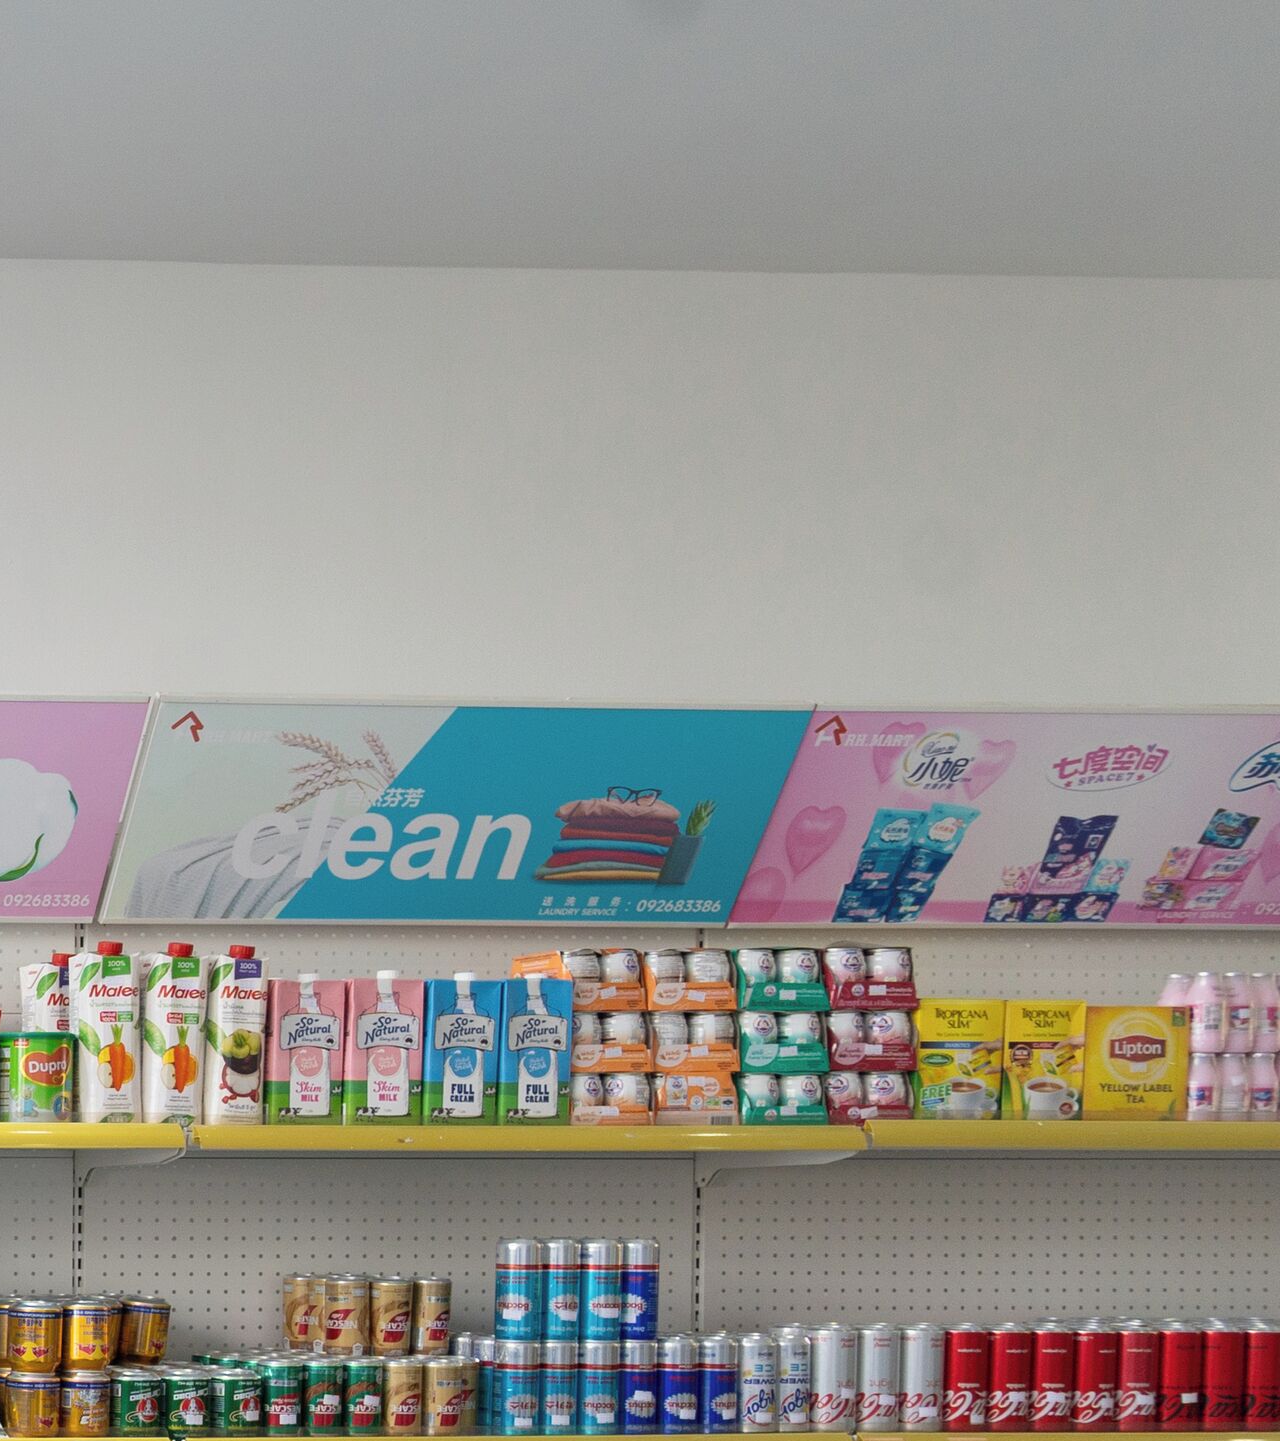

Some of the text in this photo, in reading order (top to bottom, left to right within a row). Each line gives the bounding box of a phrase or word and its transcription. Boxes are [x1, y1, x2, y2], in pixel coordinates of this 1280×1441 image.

[1052, 745, 1171, 781] 七度空间
[1077, 772, 1136, 787] SPACE7
[230, 788, 533, 881] clean
[2, 894, 91, 909] 092683386
[636, 900, 721, 914] 092683386
[538, 907, 617, 917] LAUNDRY SERVICE
[107, 960, 127, 968] 100%
[176, 961, 195, 970] 100%
[238, 962, 258, 971] 100%
[89, 983, 139, 999] Malee
[157, 984, 206, 1001] Malee
[221, 985, 270, 1002] Malee
[935, 1006, 989, 1021] TROPICANA
[1021, 1007, 1072, 1021] TROPICANA
[947, 1018, 971, 1031] SLIM
[1034, 1018, 1055, 1031] SLIM
[287, 1024, 332, 1047] Natural
[365, 1023, 411, 1047] Natural
[442, 1025, 487, 1048] Natural
[515, 1025, 559, 1048] Natural
[1113, 1040, 1163, 1058] Lipton
[28, 1058, 67, 1076] Dupro
[296, 1081, 322, 1095] Skim
[373, 1080, 401, 1095] Skim
[450, 1084, 475, 1097] FULL
[526, 1083, 550, 1096] FULL
[921, 1083, 953, 1099] FREE
[1099, 1082, 1174, 1094] YELLOW LABEL
[301, 1093, 320, 1103] MILK
[379, 1092, 399, 1102] MILK
[450, 1095, 475, 1103] CREAM
[525, 1095, 550, 1103] CREAM
[1125, 1093, 1146, 1104] TEA
